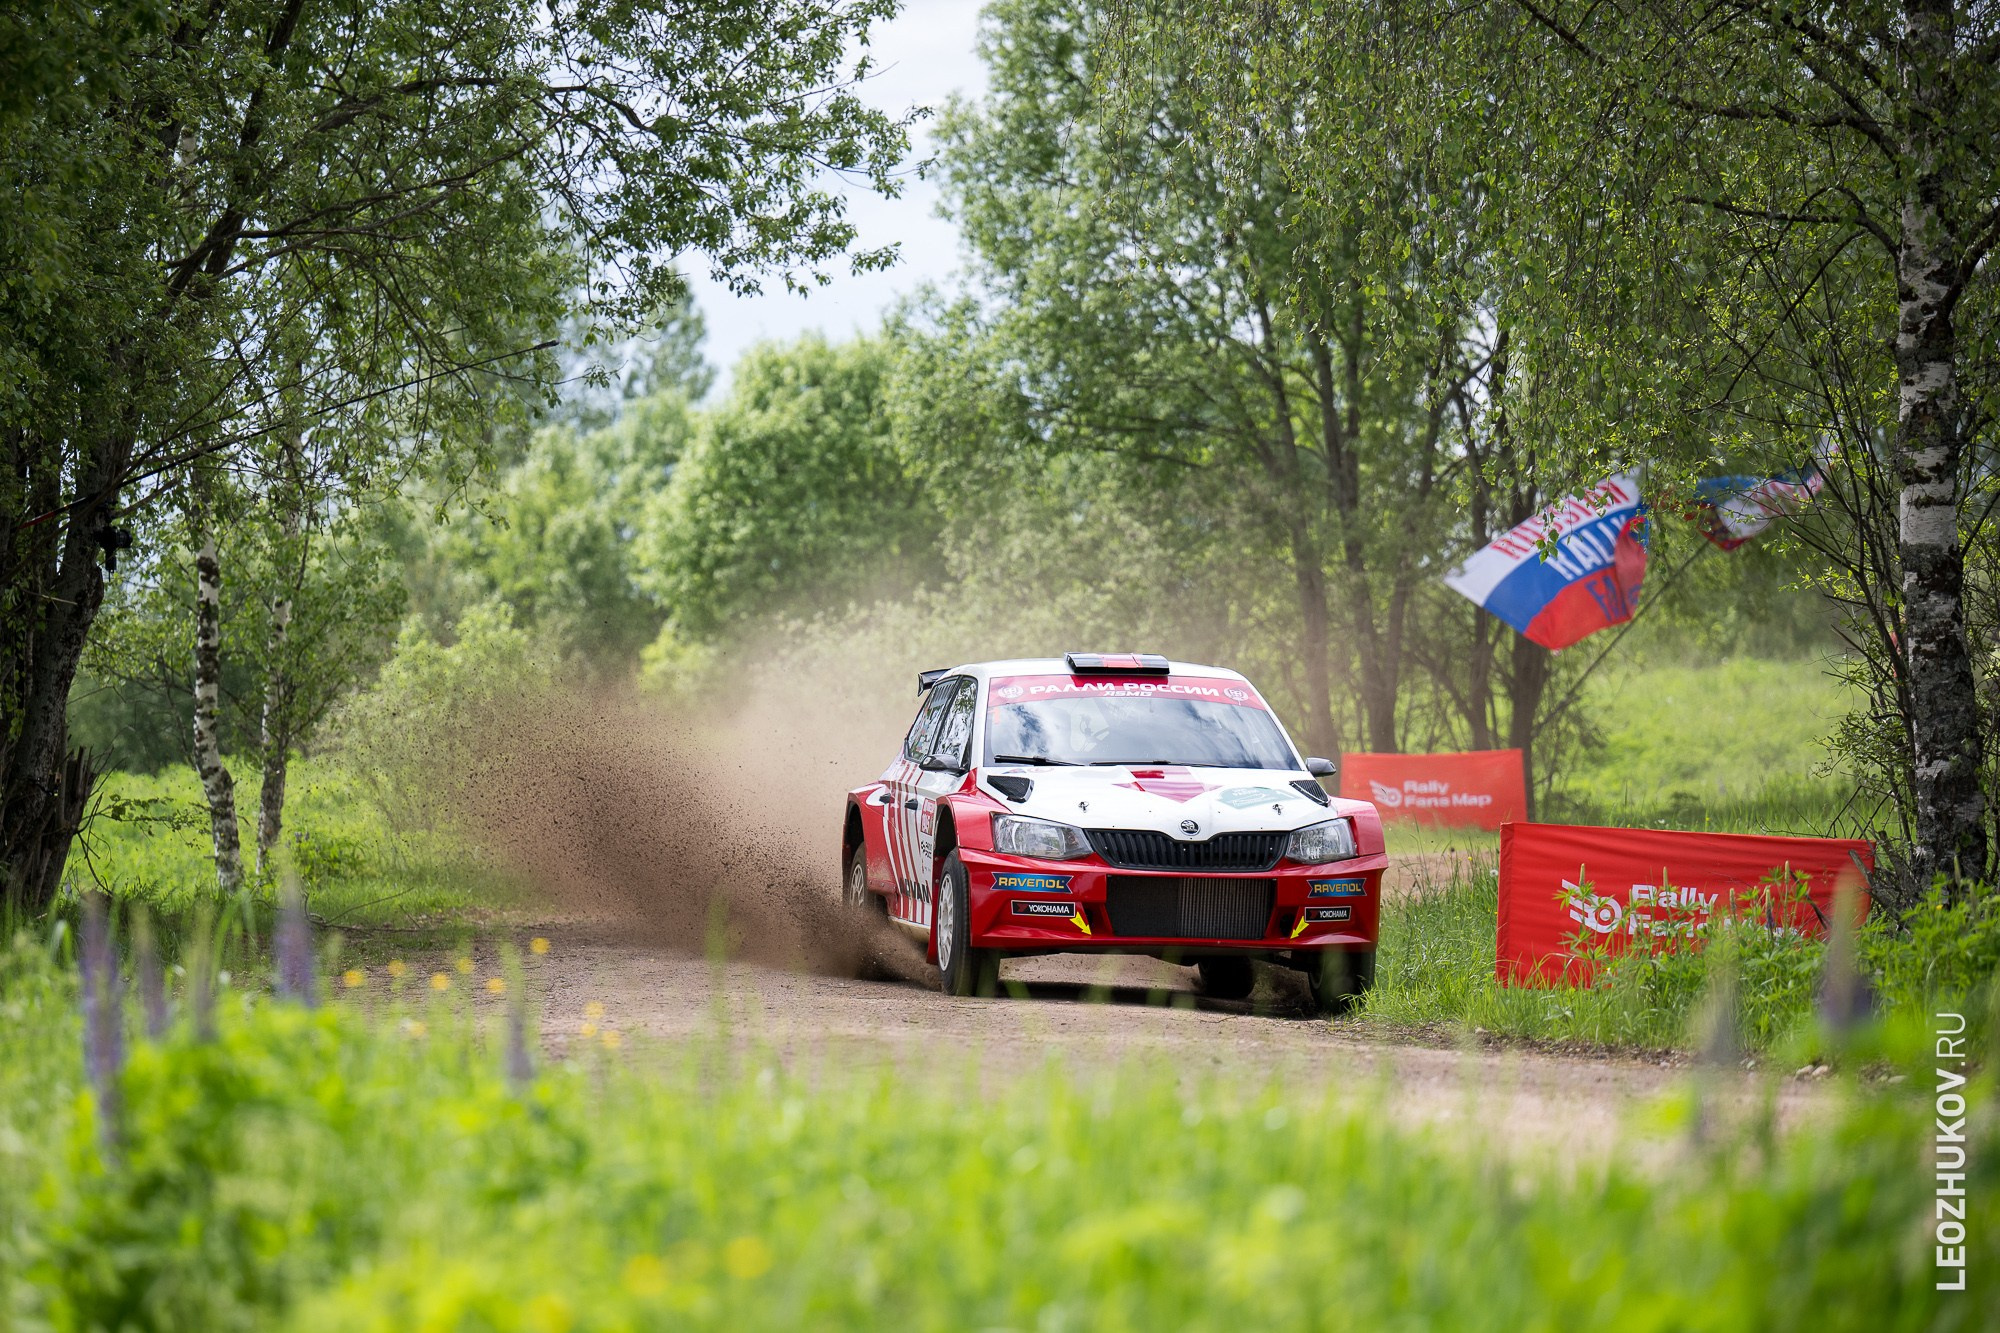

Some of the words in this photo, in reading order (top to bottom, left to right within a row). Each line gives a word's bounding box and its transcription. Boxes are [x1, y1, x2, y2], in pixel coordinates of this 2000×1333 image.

[1029, 682, 1116, 695] РАЛЛИ
[1122, 682, 1220, 697] РОССИИ
[1403, 780, 1449, 795] Rally
[1404, 795, 1450, 808] Fans
[1452, 793, 1493, 808] Map
[998, 876, 1065, 889] RAVENOL
[1314, 882, 1361, 893] RAVENOL
[1631, 884, 1719, 915] Rally
[1028, 904, 1070, 914] YOKOHAMA
[1319, 910, 1347, 918] YOKOHAMA
